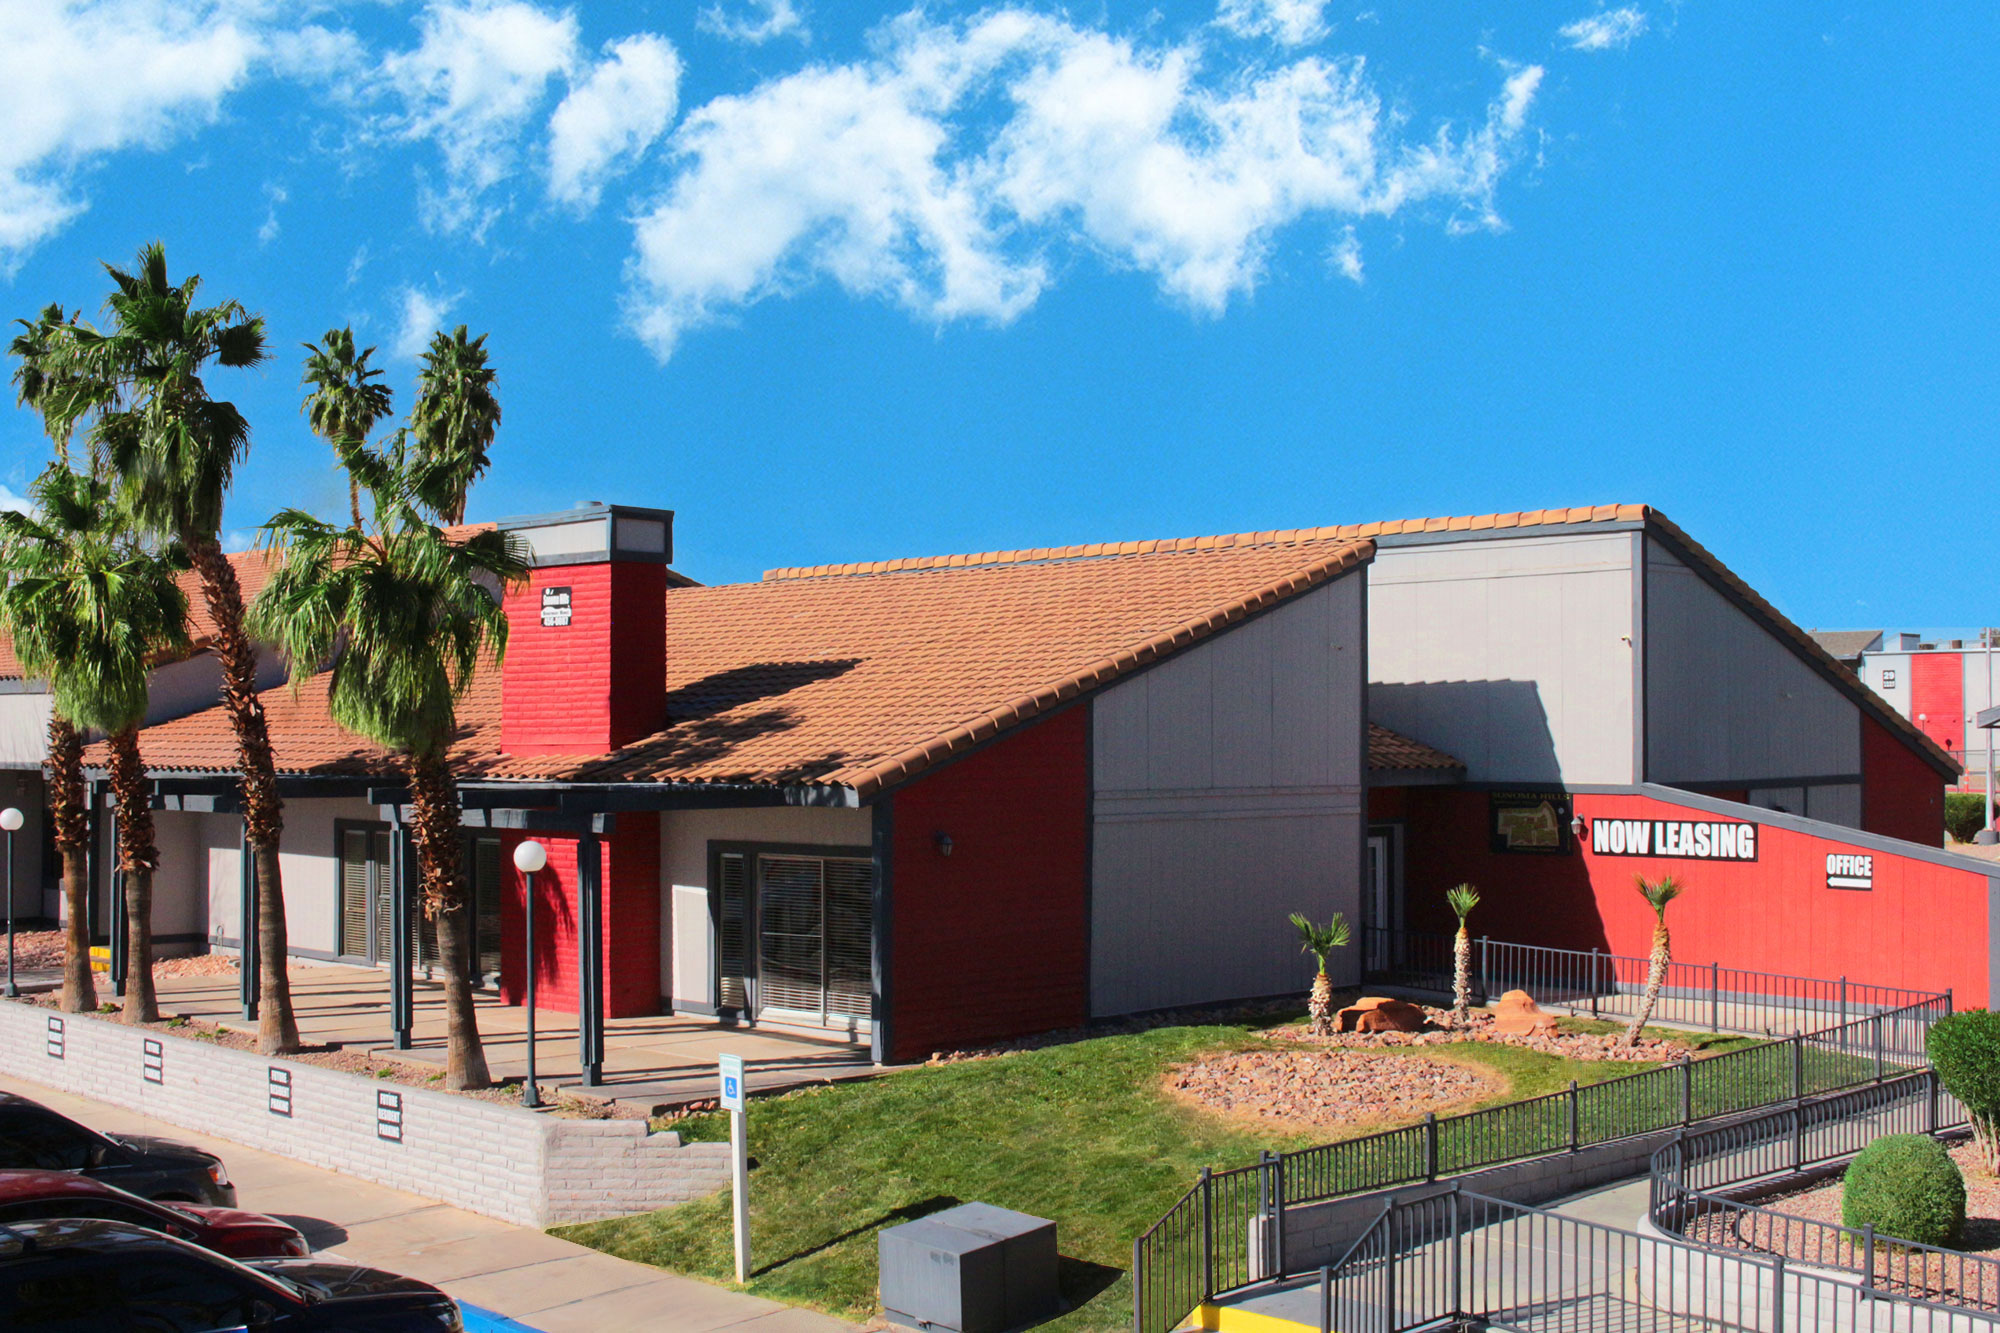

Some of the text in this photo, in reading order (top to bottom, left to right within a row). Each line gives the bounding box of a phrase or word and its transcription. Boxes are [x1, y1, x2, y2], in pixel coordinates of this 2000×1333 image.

[1883, 672, 1895, 680] 29
[1492, 792, 1571, 801] SONOMA HILLS
[1593, 820, 1754, 858] NOW LEASING
[1826, 854, 1872, 876] OFFICE
[270, 1097, 289, 1112] PARKING
[379, 1092, 398, 1107] FUTURE
[377, 1107, 401, 1123] RESIDENT
[378, 1123, 400, 1138] PARKING
